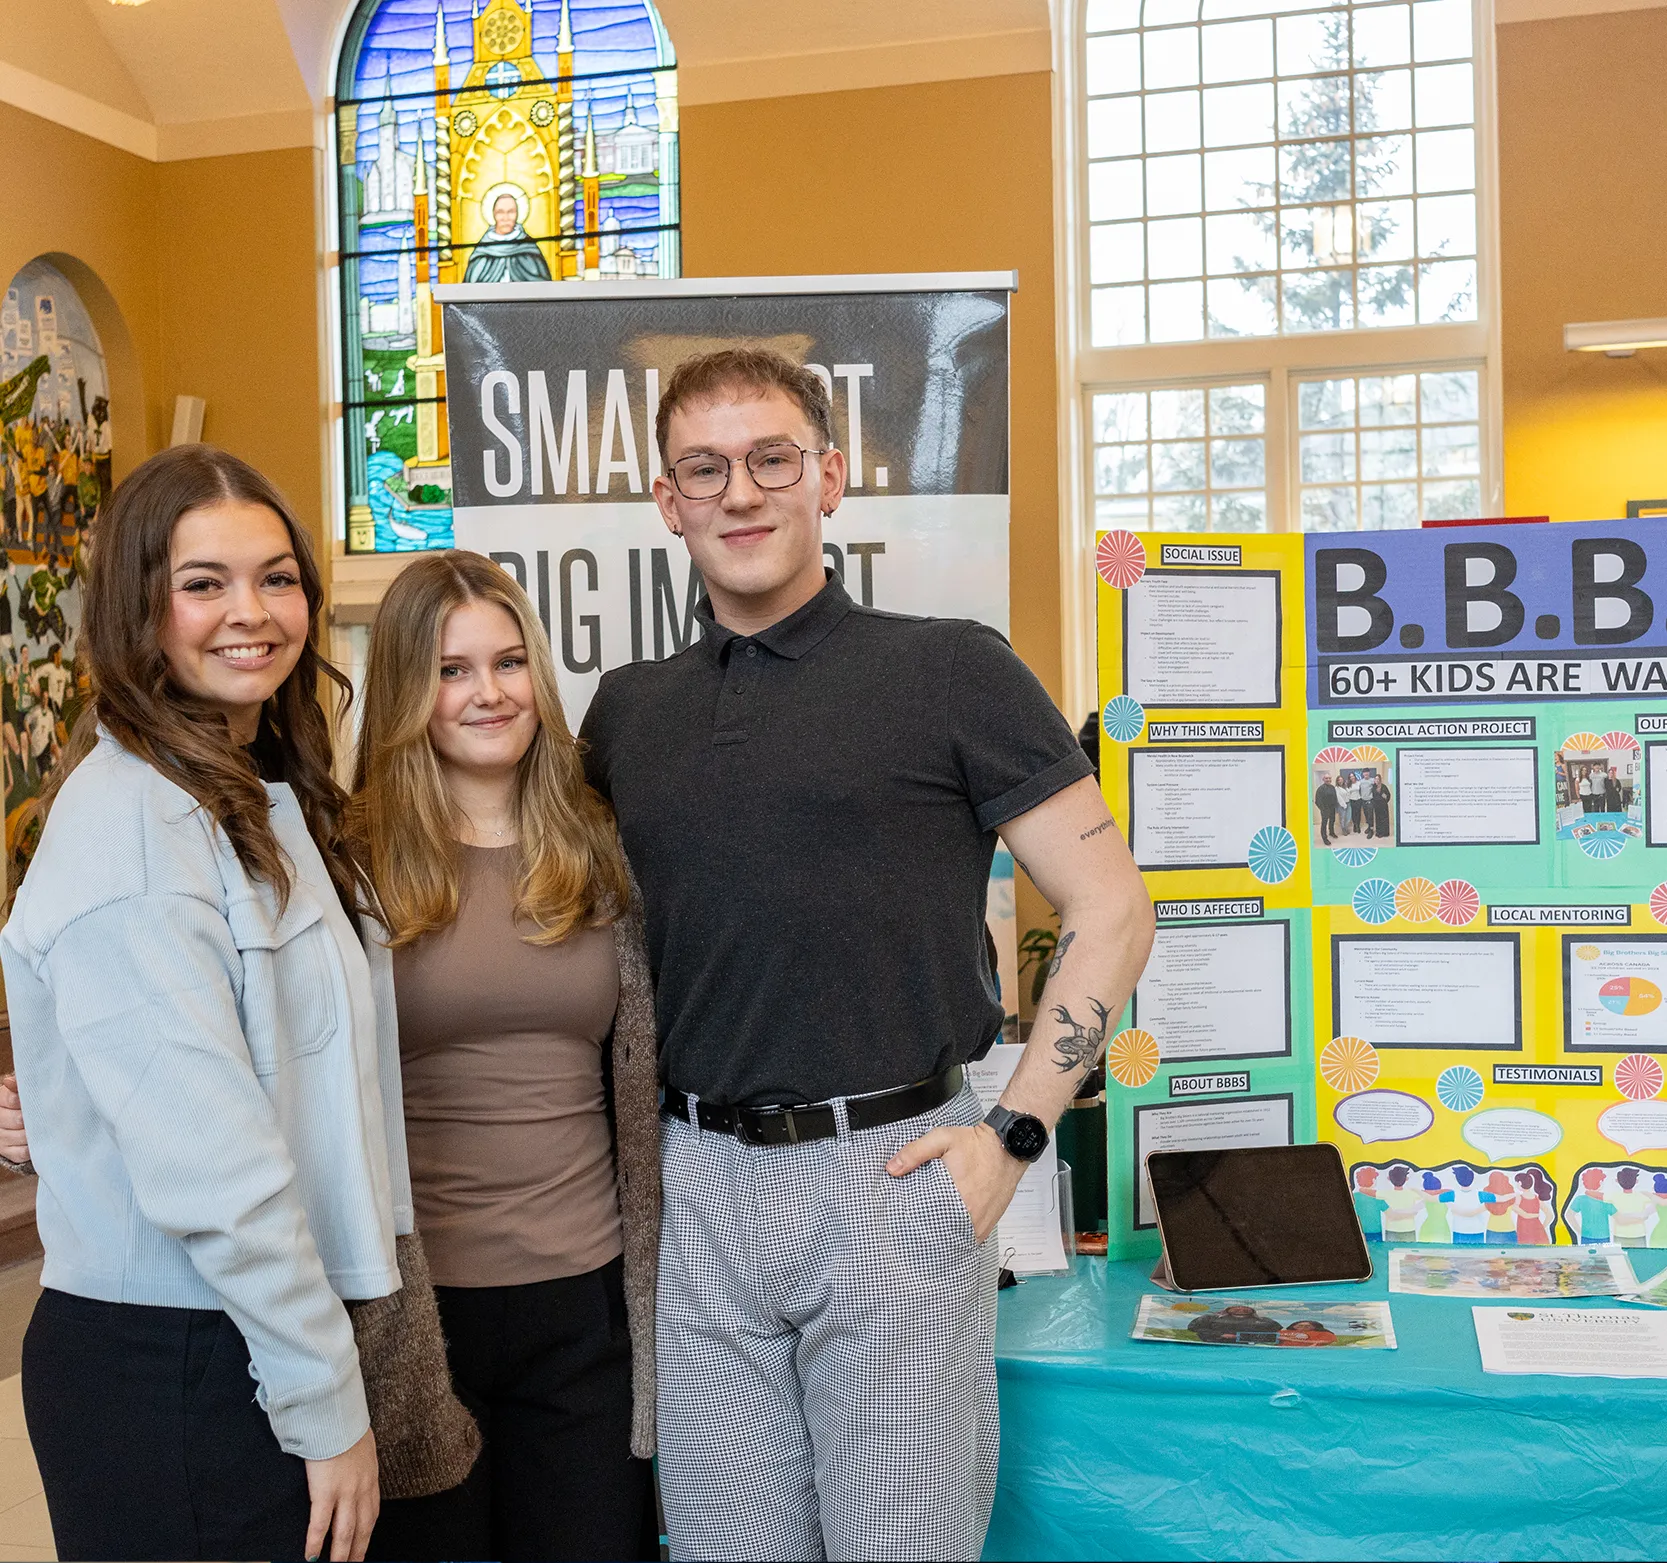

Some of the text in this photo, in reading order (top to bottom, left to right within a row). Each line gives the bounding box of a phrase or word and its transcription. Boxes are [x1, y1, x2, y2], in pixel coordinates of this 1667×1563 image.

[481, 368, 661, 497] SMA
[1165, 548, 1239, 561] SOCIAL ISSUE
[1331, 665, 1397, 695] 60+
[1411, 662, 1496, 693] KIDS
[1506, 662, 1582, 692] ARE
[1150, 725, 1261, 736] WHY THIS MATTERS
[1334, 722, 1530, 738] OUR SOCIAL ACTION PROJECT
[1158, 903, 1259, 915] WHO IS AFFECTED
[1494, 909, 1625, 920] LOCAL MENTORING
[1498, 1069, 1597, 1081] TESTIMONIALS
[1173, 1077, 1245, 1091] ABOUT BBBS
